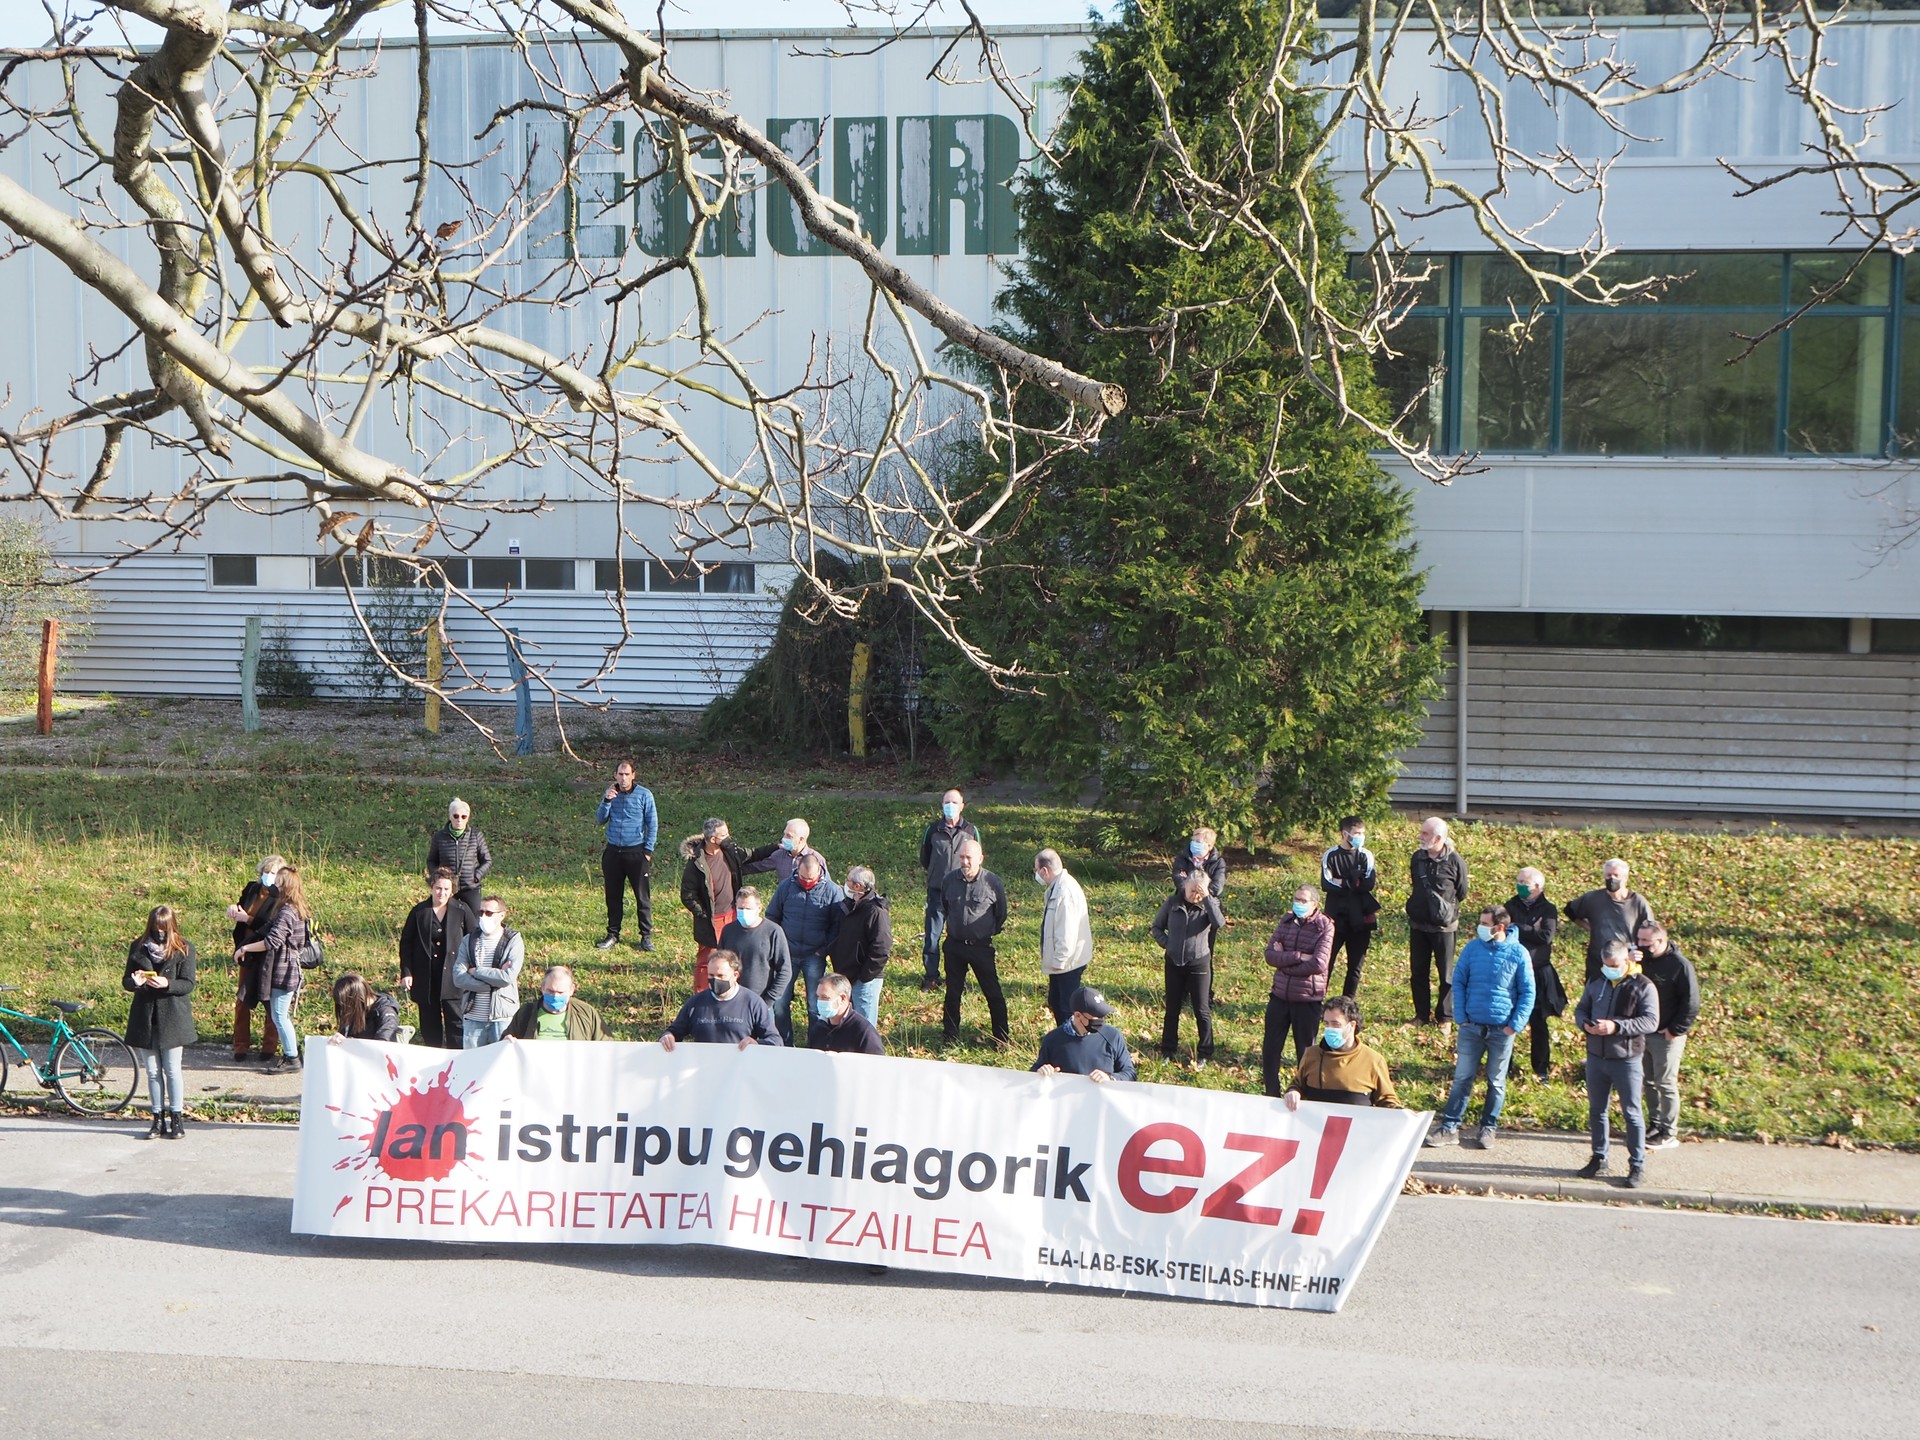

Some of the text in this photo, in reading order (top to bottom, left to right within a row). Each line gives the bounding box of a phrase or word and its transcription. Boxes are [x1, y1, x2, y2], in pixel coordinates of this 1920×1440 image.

[526, 114, 1020, 258] EGUR
[365, 1186, 992, 1261] PREKARIETATEA HILTZAILEA
[369, 1111, 1352, 1236] lan istripu gehiagorik ez!
[1037, 1247, 1345, 1296] ELA-LAB-ESK-STEILAS-EHNE-HIR
